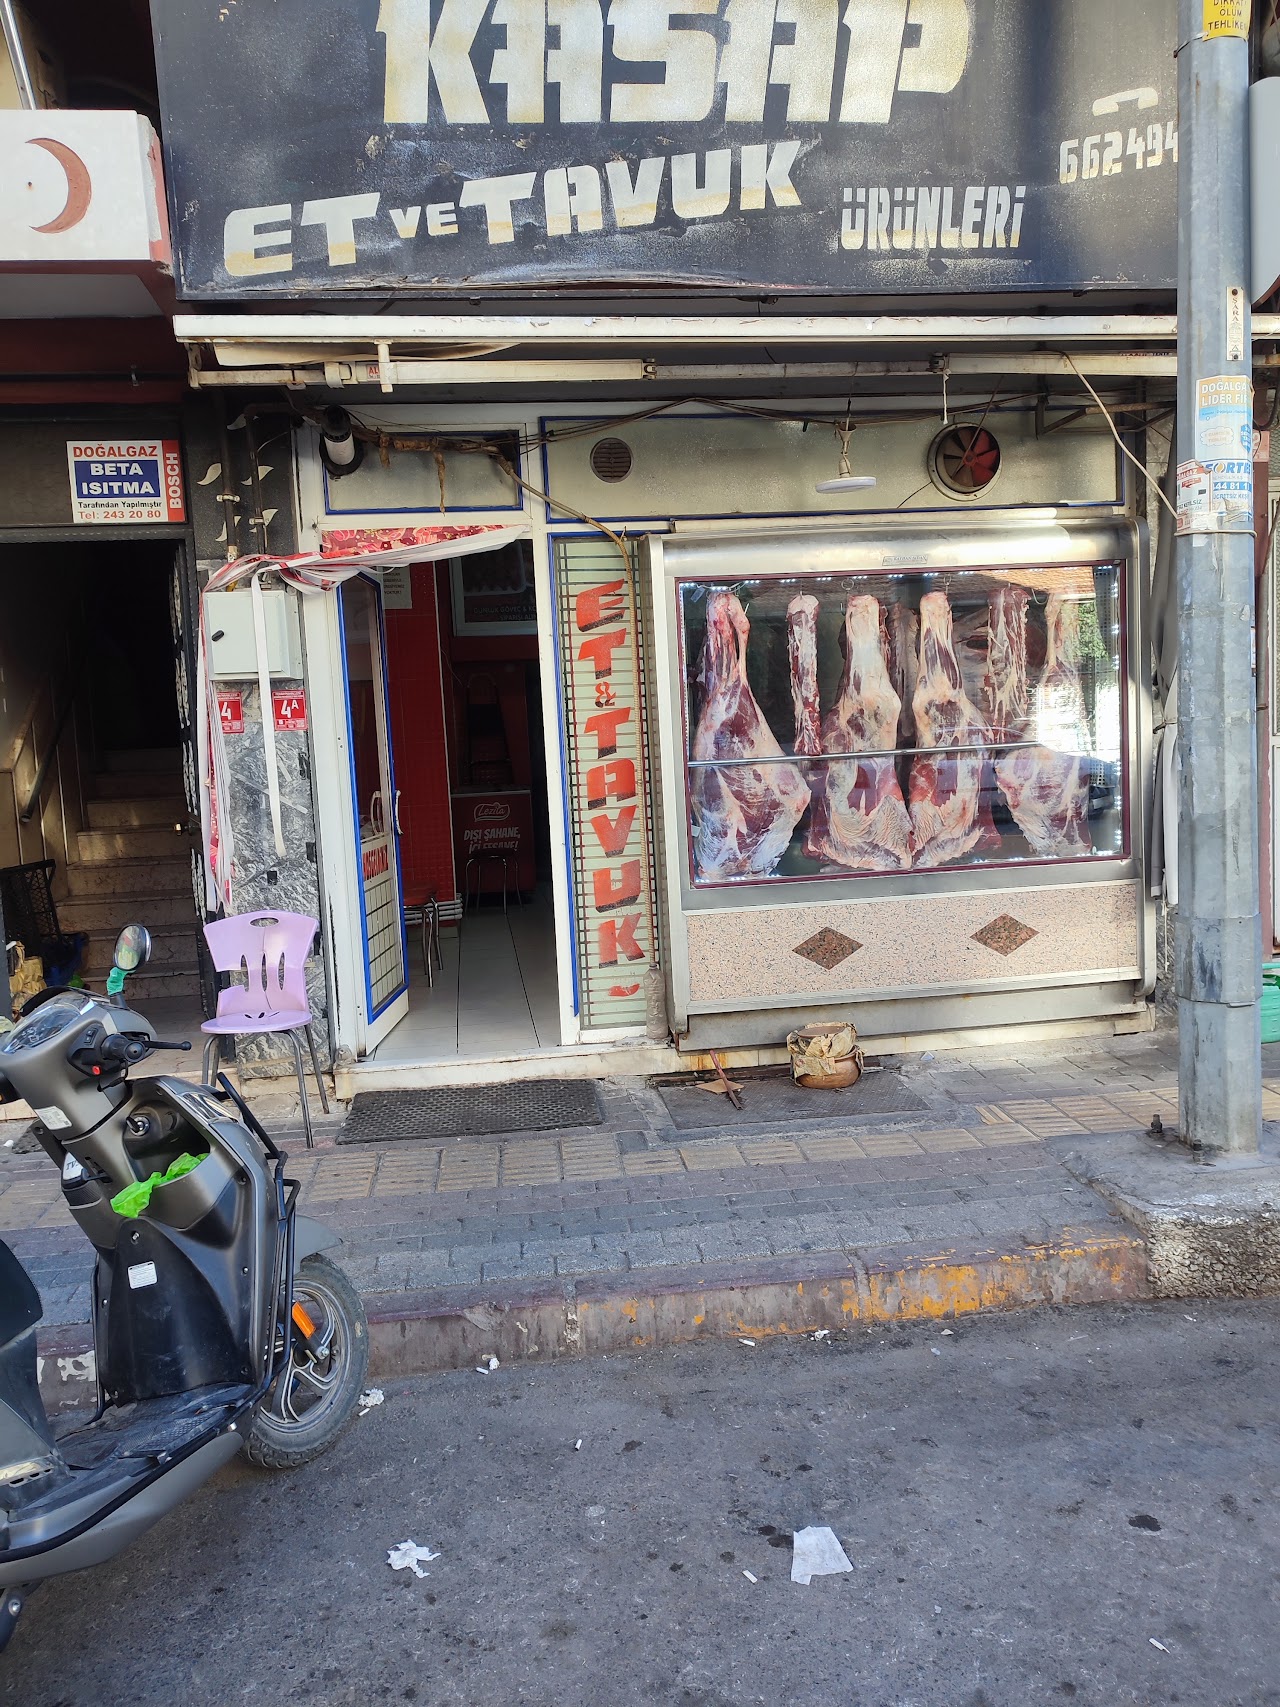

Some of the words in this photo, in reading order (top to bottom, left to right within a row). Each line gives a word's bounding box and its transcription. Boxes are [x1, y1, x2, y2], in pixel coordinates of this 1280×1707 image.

[1220, 5, 1242, 16] ÖLÜM
[1208, 17, 1247, 31] TEHLİKE
[376, 0, 970, 124] KASAP
[223, 192, 381, 276] ET
[389, 202, 459, 238] VE
[459, 140, 802, 245] TAVUK
[841, 185, 1027, 250] ÜRÜNLERİ
[1202, 393, 1232, 406] LİDER
[73, 443, 158, 458] DOĞALGAZ
[90, 463, 144, 476] BETA
[165, 452, 182, 509] BOSCH
[1230, 483, 1240, 491] 81
[81, 481, 155, 495] ISITMA
[78, 501, 119, 509] Tarafından
[121, 500, 162, 509] Yapılmıştır
[78, 511, 100, 519] Tel:
[103, 510, 125, 519] 243
[128, 510, 143, 519] 20
[147, 510, 161, 518] 80
[576, 578, 628, 680] ET
[595, 681, 617, 709] &
[221, 701, 232, 720] 4
[478, 804, 506, 817] Lezita
[484, 827, 520, 841] ŞAHANE,
[584, 706, 646, 969] TAVUK
